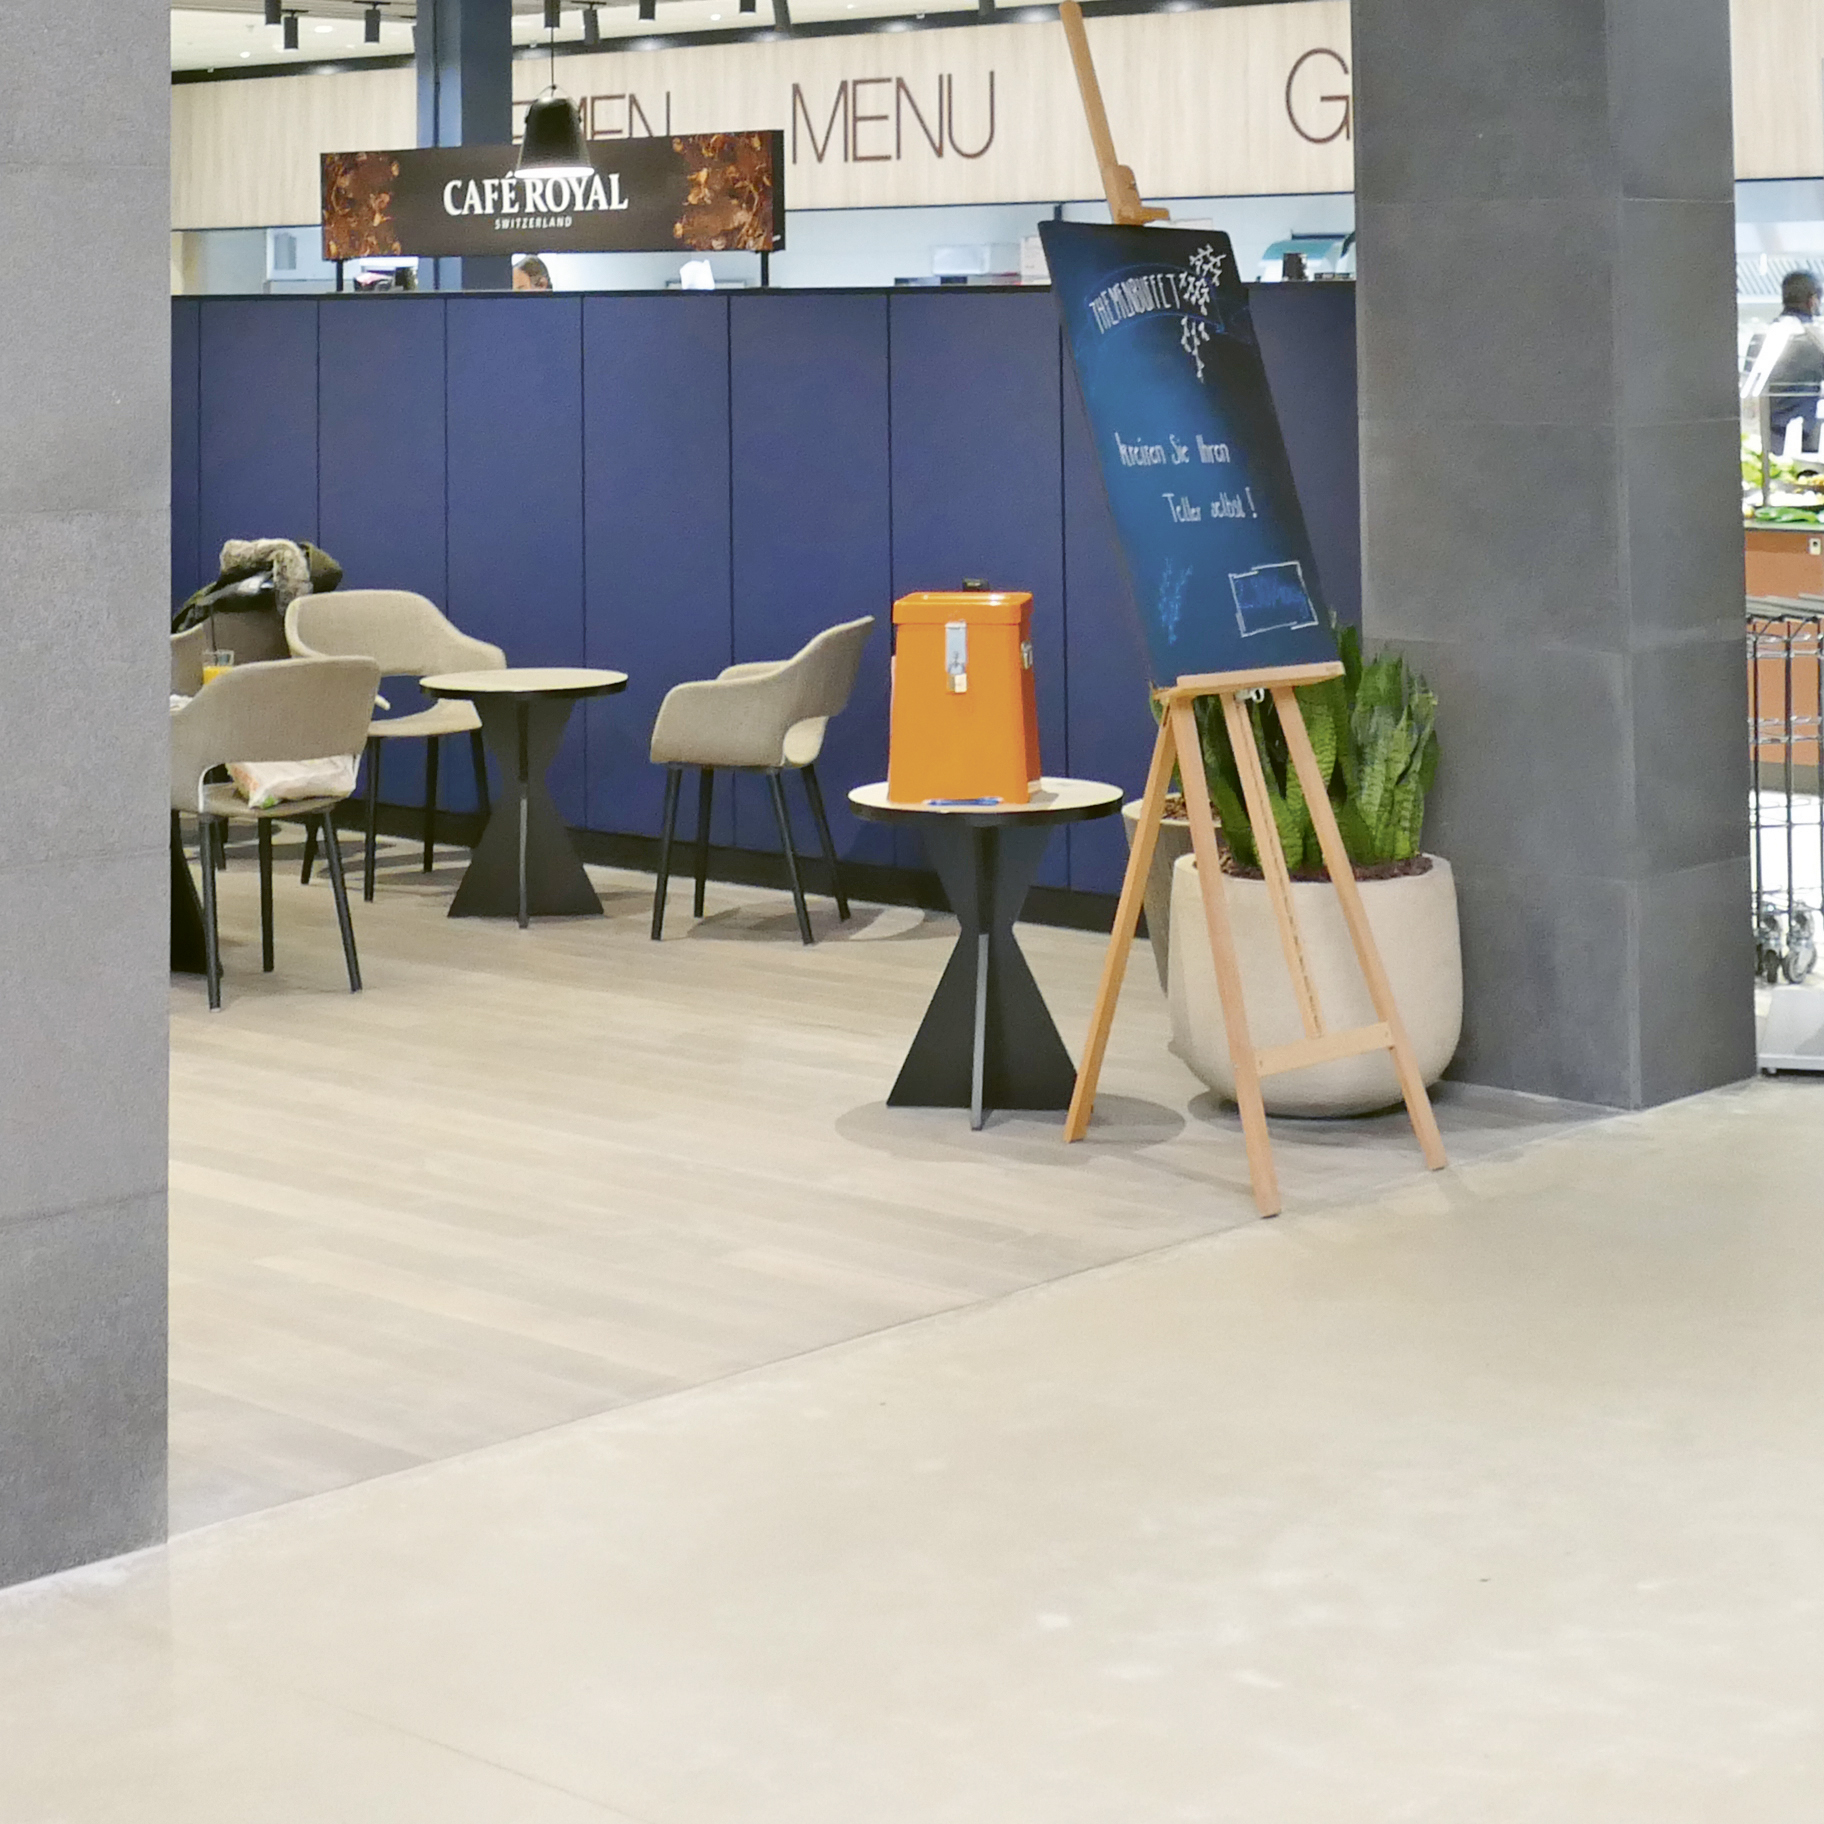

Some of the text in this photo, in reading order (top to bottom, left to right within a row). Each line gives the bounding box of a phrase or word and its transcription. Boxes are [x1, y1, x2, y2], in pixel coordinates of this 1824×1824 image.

[791, 70, 995, 165] MENU
[442, 171, 629, 216] CAFÉ ROYAL
[494, 215, 573, 231] SWITZERLAND
[1169, 433, 1190, 466] Sie
[1161, 492, 1202, 523] Teller
